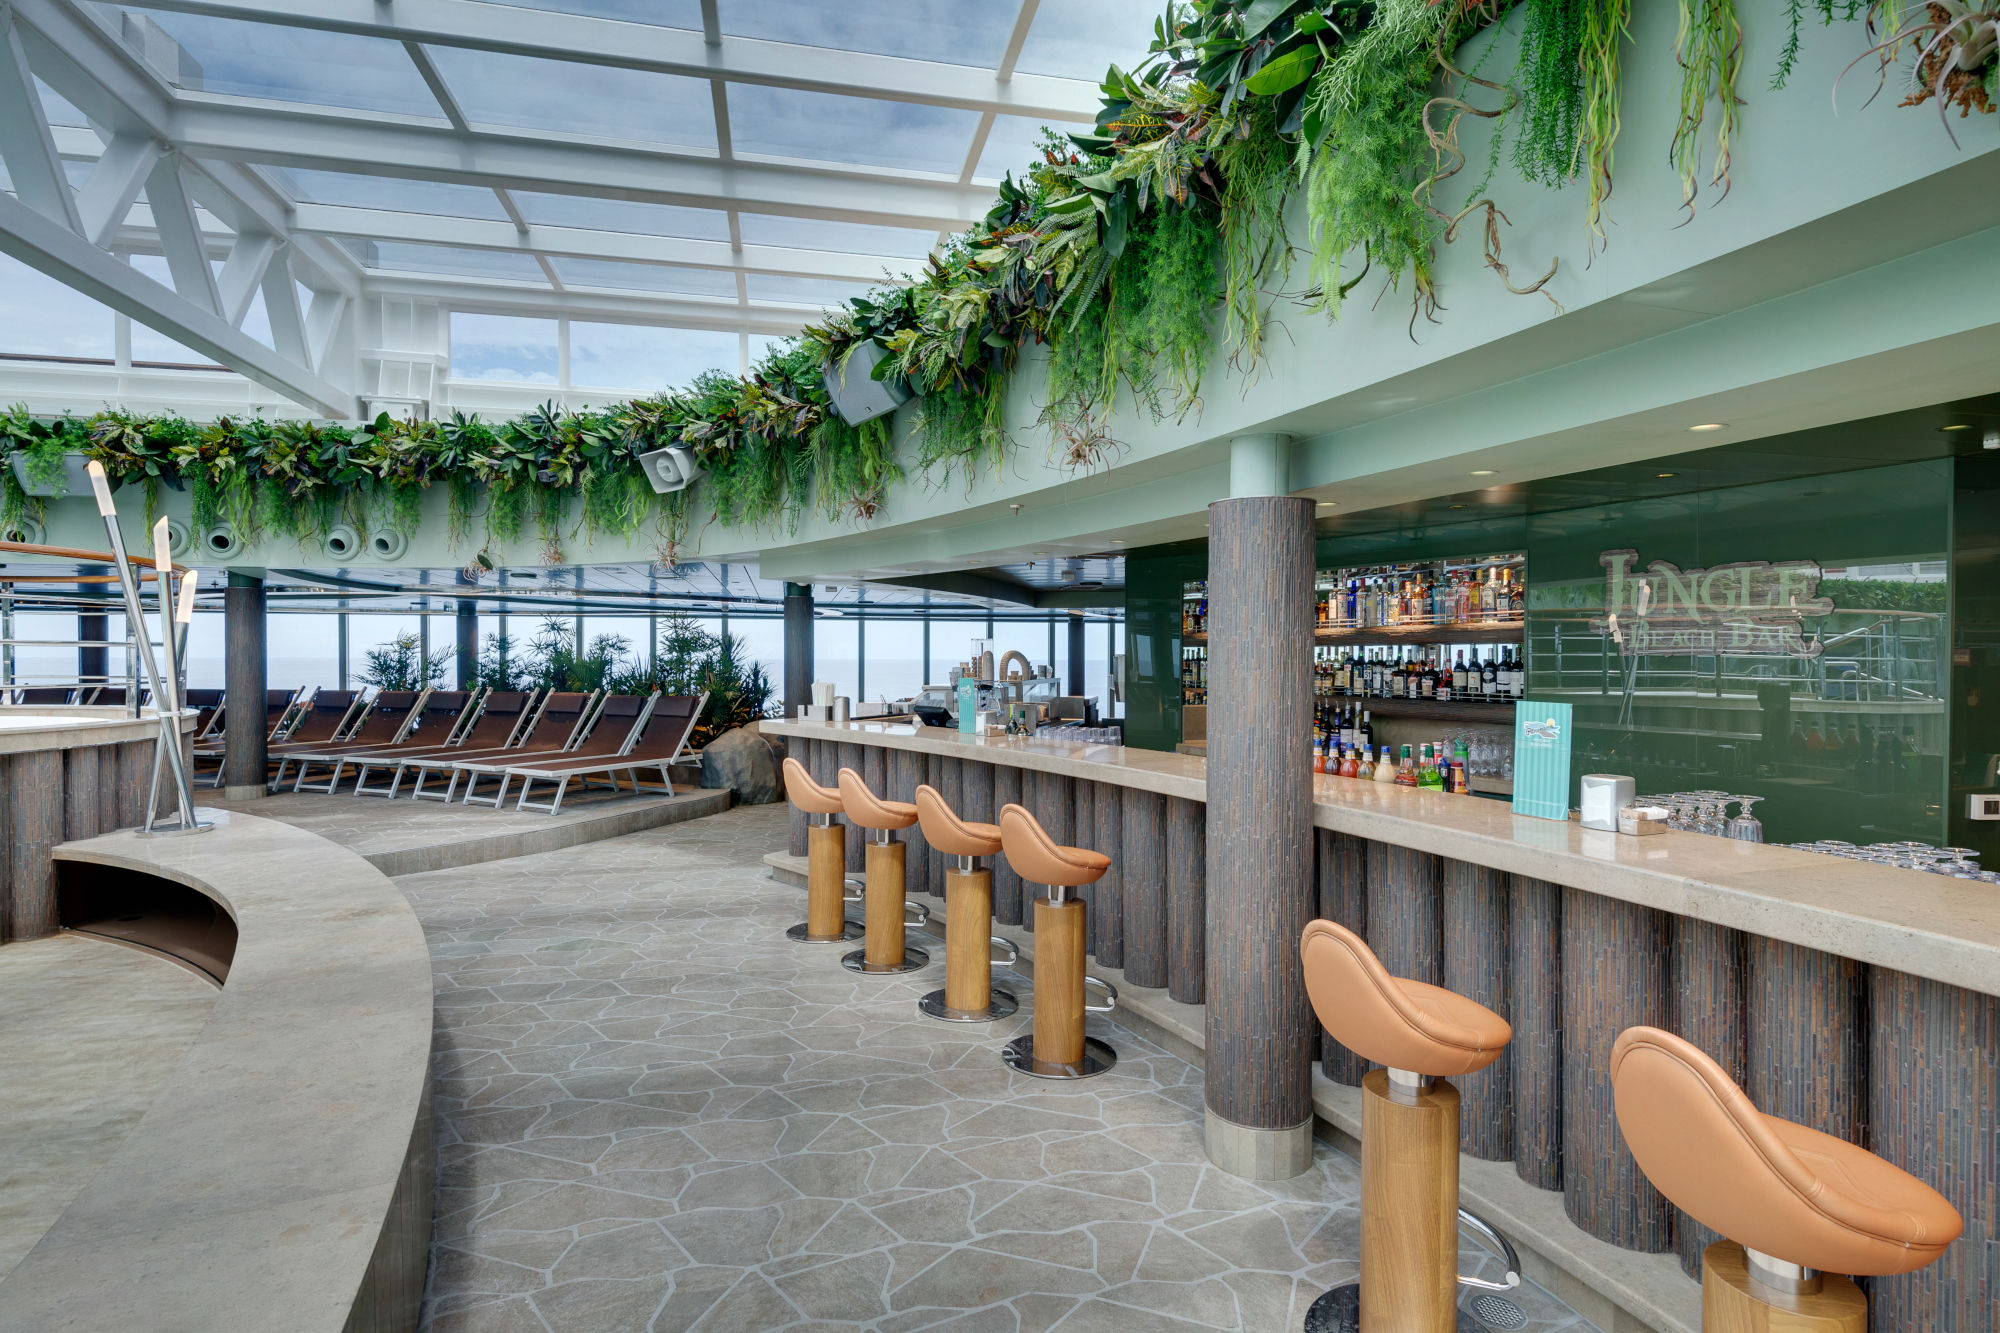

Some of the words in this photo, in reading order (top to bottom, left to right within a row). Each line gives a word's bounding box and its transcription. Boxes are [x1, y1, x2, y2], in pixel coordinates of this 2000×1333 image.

[1595, 554, 1823, 627] JUNGLE
[1621, 619, 1716, 649] BEACH
[1721, 616, 1815, 653] BAR
